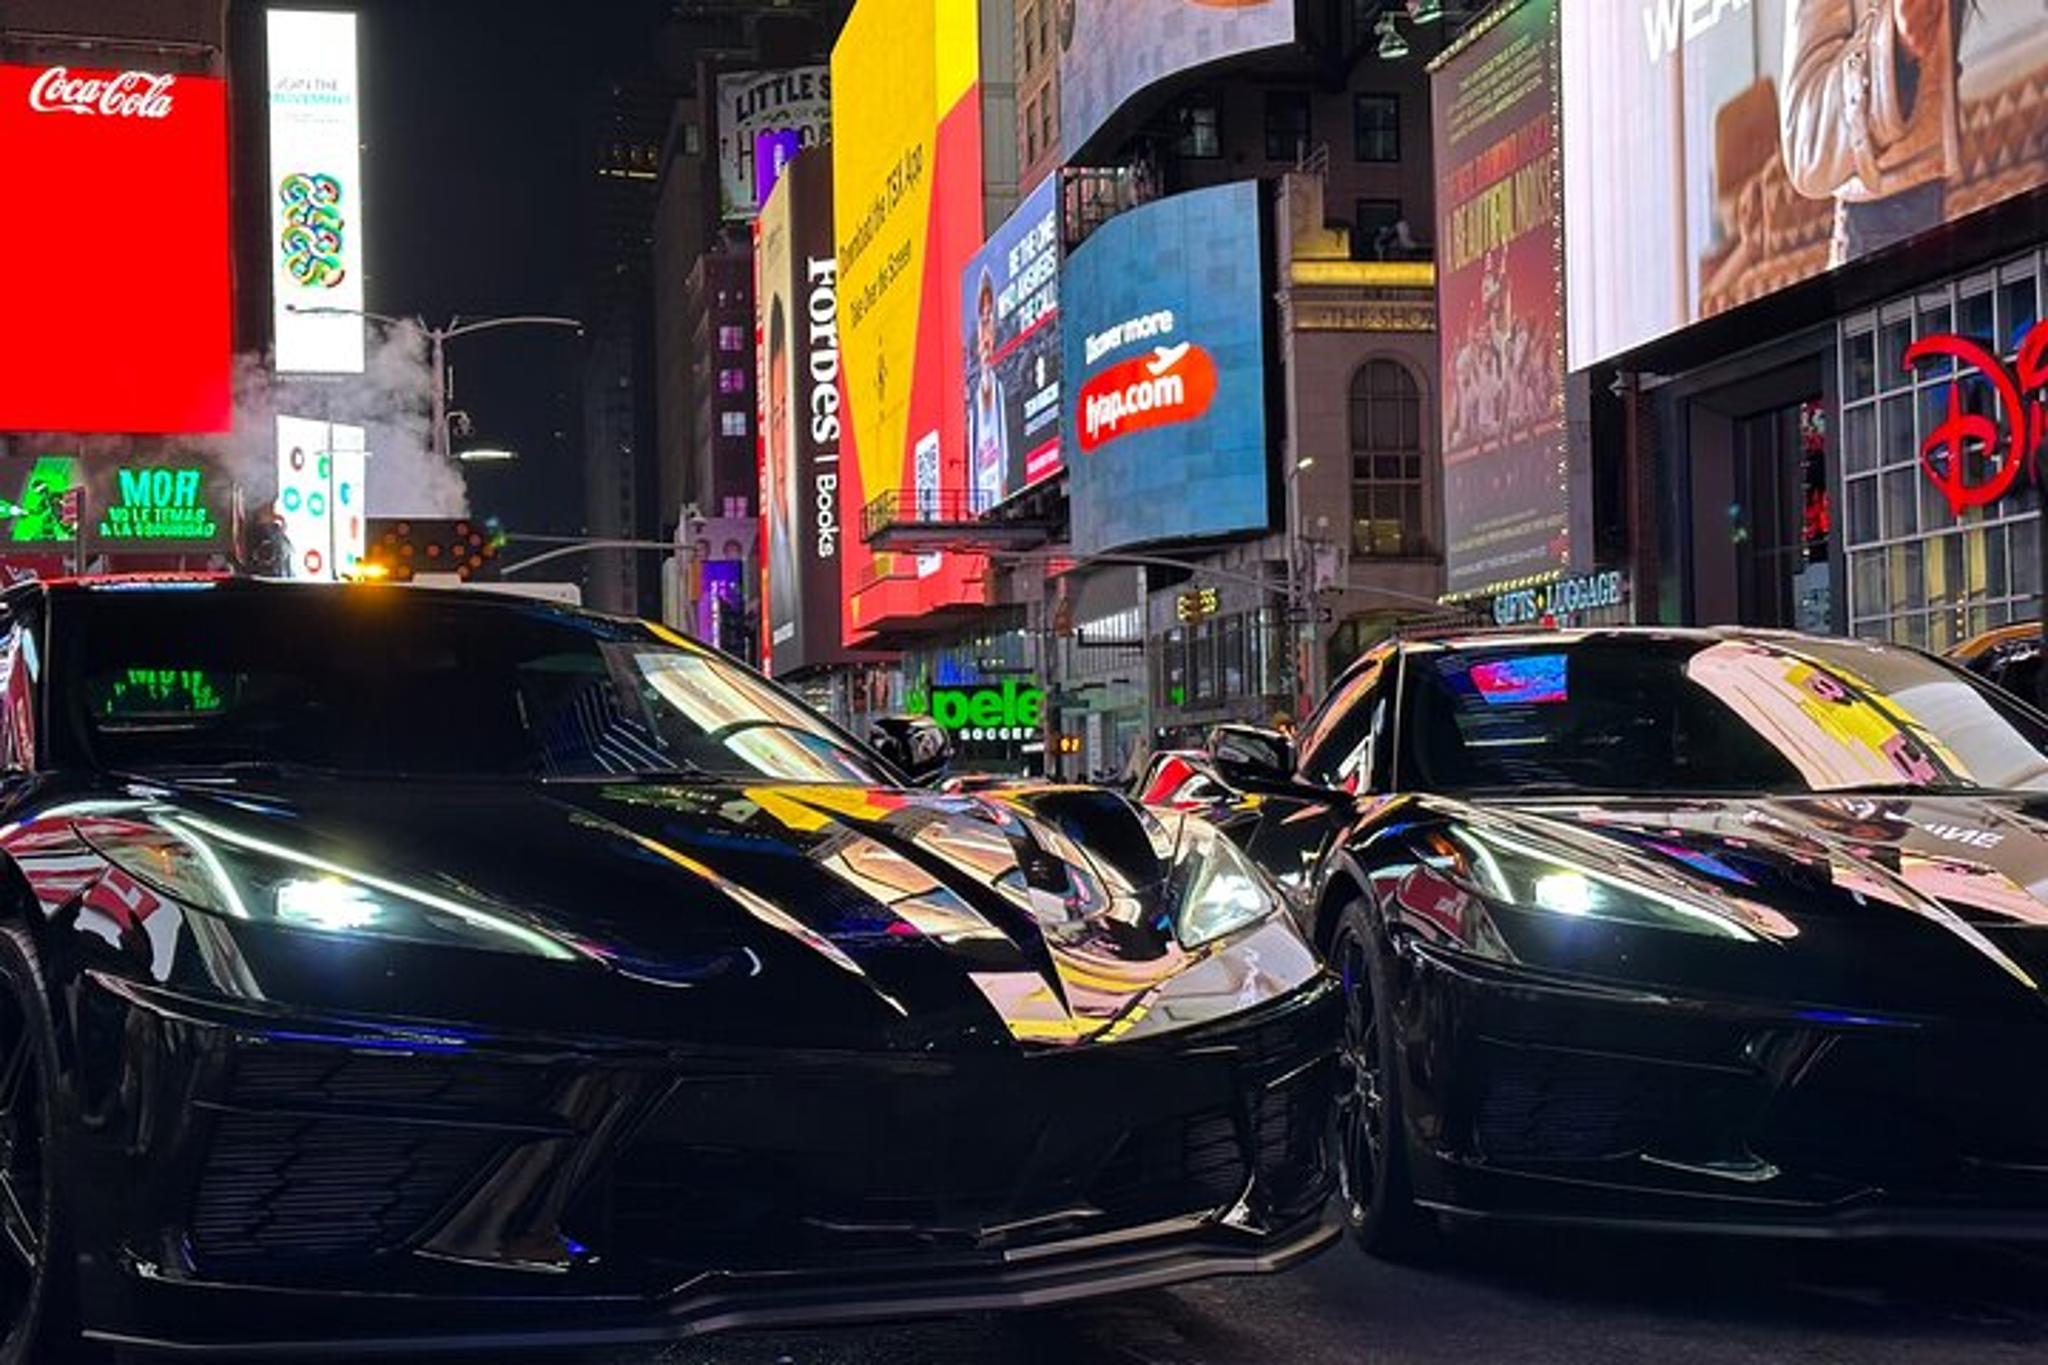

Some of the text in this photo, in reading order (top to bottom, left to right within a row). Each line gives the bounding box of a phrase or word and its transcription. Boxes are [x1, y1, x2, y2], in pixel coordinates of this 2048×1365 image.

[29, 65, 176, 119] Coca-Cola
[736, 72, 814, 123] LITTLE
[119, 469, 201, 508] MOR
[816, 473, 839, 558] Books
[1493, 588, 1537, 624] GIFTS
